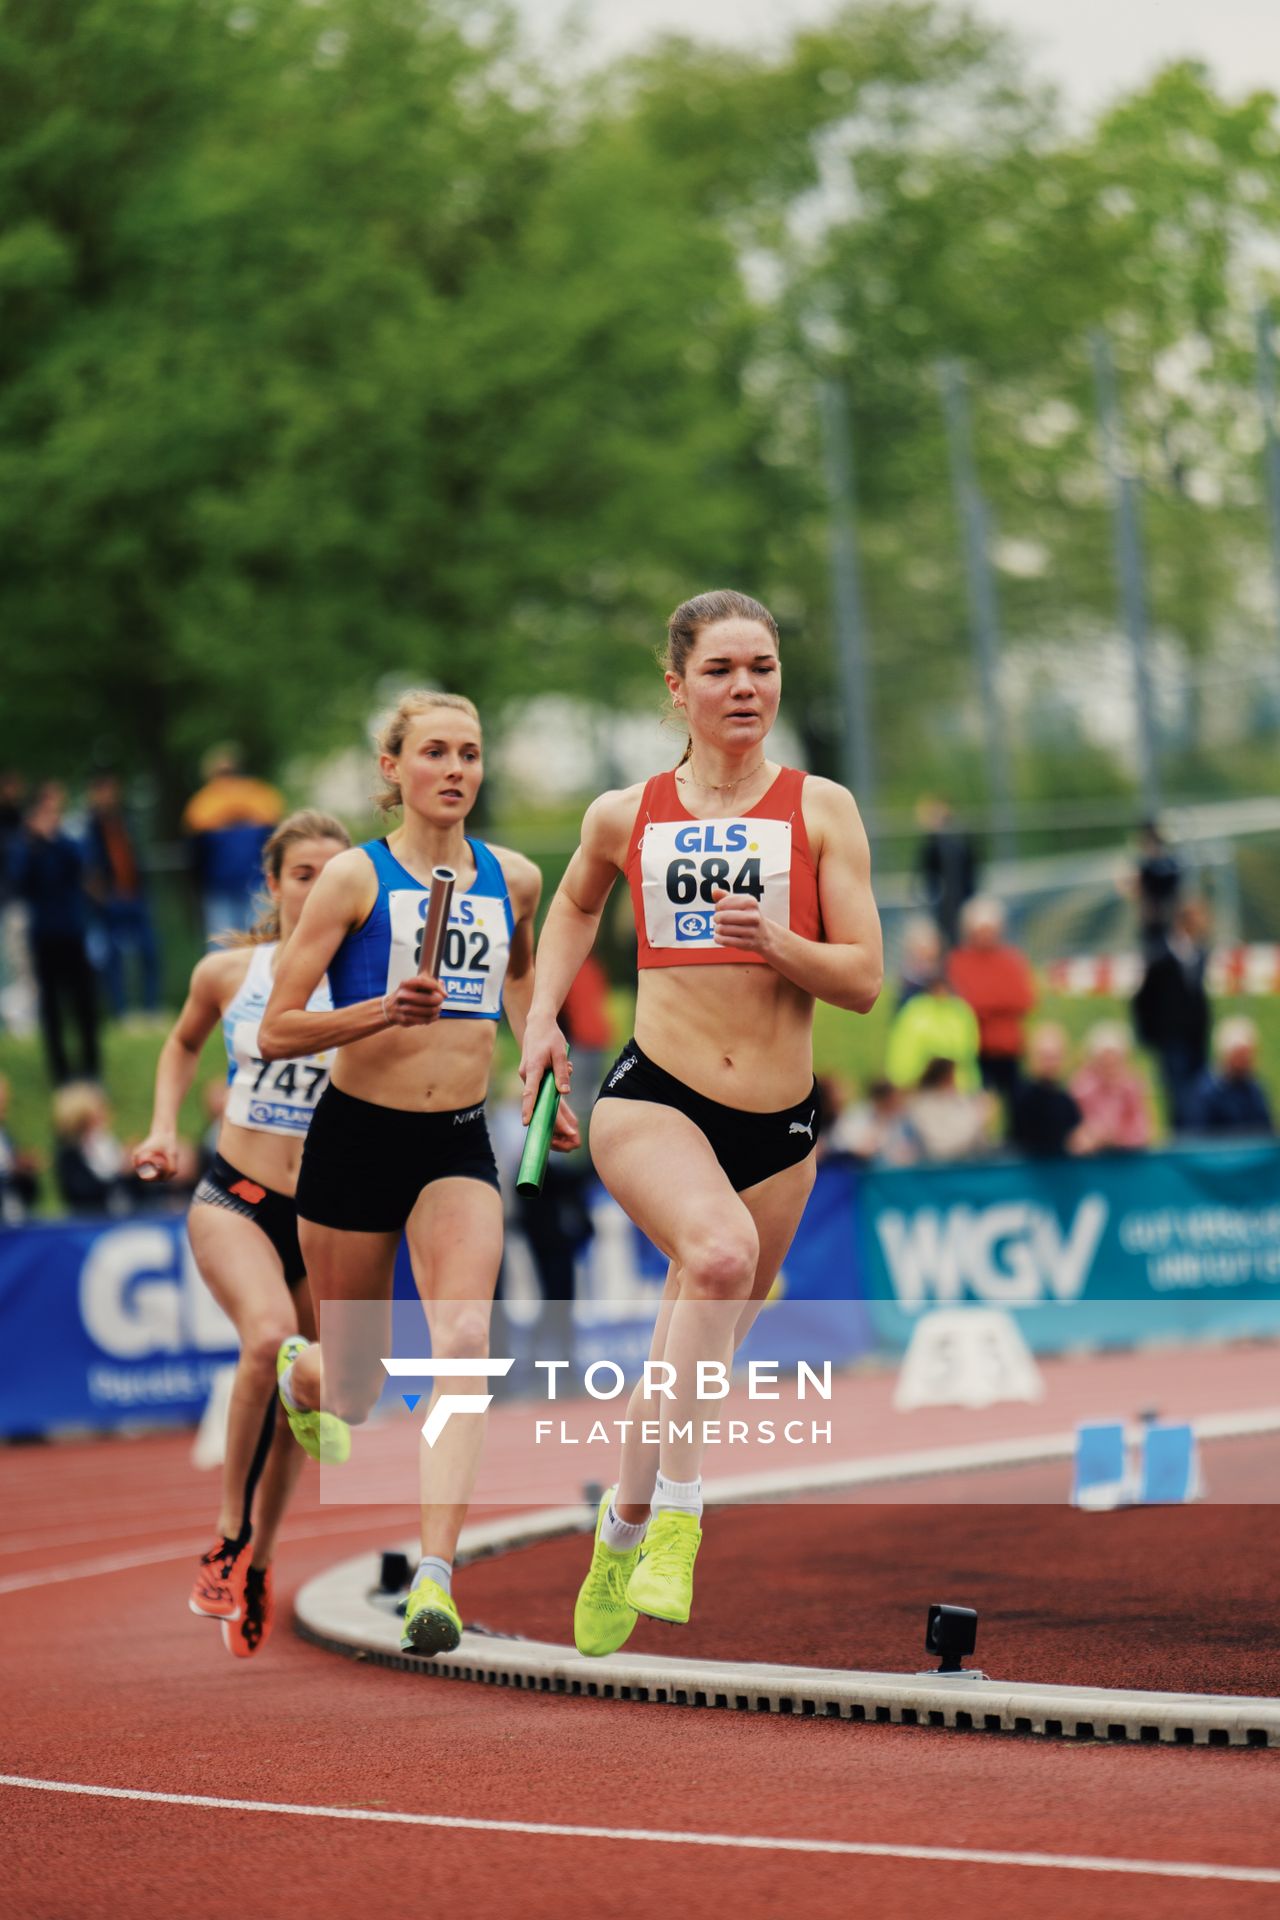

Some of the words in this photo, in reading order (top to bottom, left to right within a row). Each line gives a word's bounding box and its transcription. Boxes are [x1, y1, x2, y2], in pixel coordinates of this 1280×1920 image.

[665, 857, 765, 905] 684
[447, 981, 482, 995] PLAN
[251, 1057, 328, 1102] 747
[877, 1195, 1107, 1314] WGV
